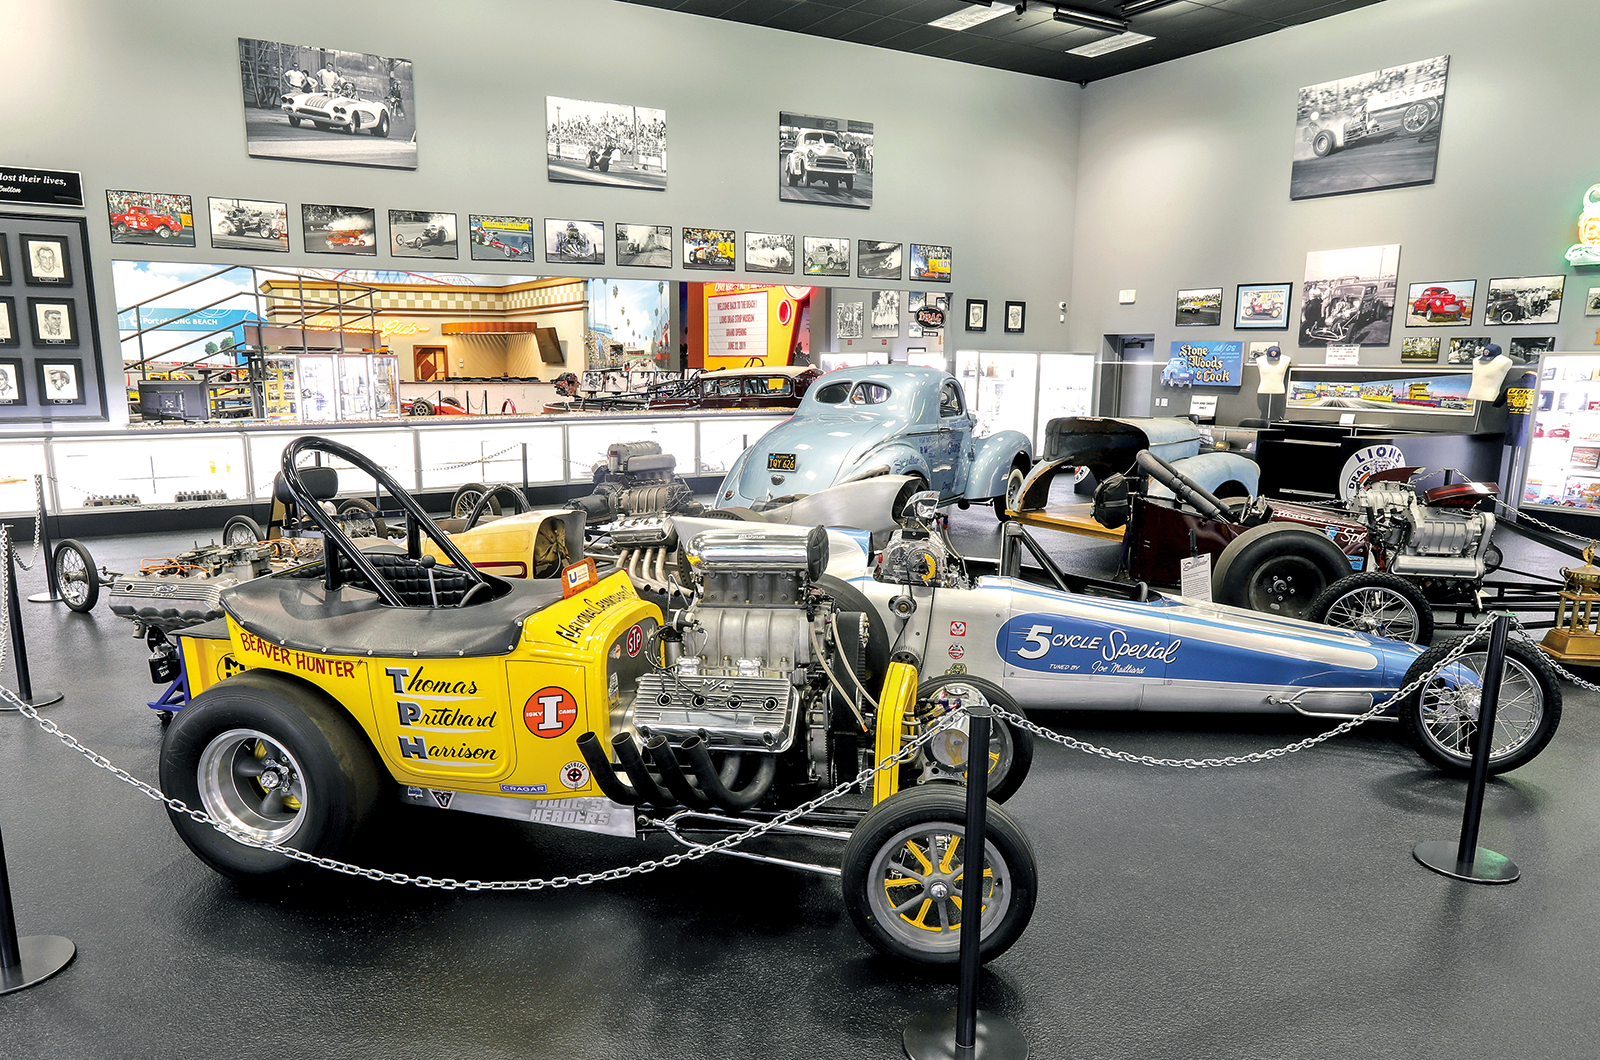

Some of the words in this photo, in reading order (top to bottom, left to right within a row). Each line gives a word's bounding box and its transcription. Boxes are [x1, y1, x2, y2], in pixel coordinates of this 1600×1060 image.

[19, 174, 41, 184] their
[43, 176, 67, 187] lives,
[143, 317, 159, 325] Port
[1179, 344, 1209, 357] Stone
[1188, 355, 1224, 370] Woods
[1196, 370, 1202, 380] &
[1203, 368, 1230, 383] Cook
[782, 459, 795, 469] 626
[1349, 465, 1370, 489] DRAG
[628, 628, 641, 653] STP
[1017, 624, 1053, 660] 5
[1052, 634, 1103, 650] CYCLE
[1102, 630, 1182, 665] Special
[240, 632, 292, 666] BEAVER
[1091, 660, 1109, 674] Joe
[385, 666, 478, 694] Thomas
[703, 679, 732, 692] M/T
[397, 700, 498, 728] Pritchard
[397, 735, 501, 760] Harrison
[564, 762, 586, 772] AUTOLITE
[529, 808, 612, 826] HEADERS
